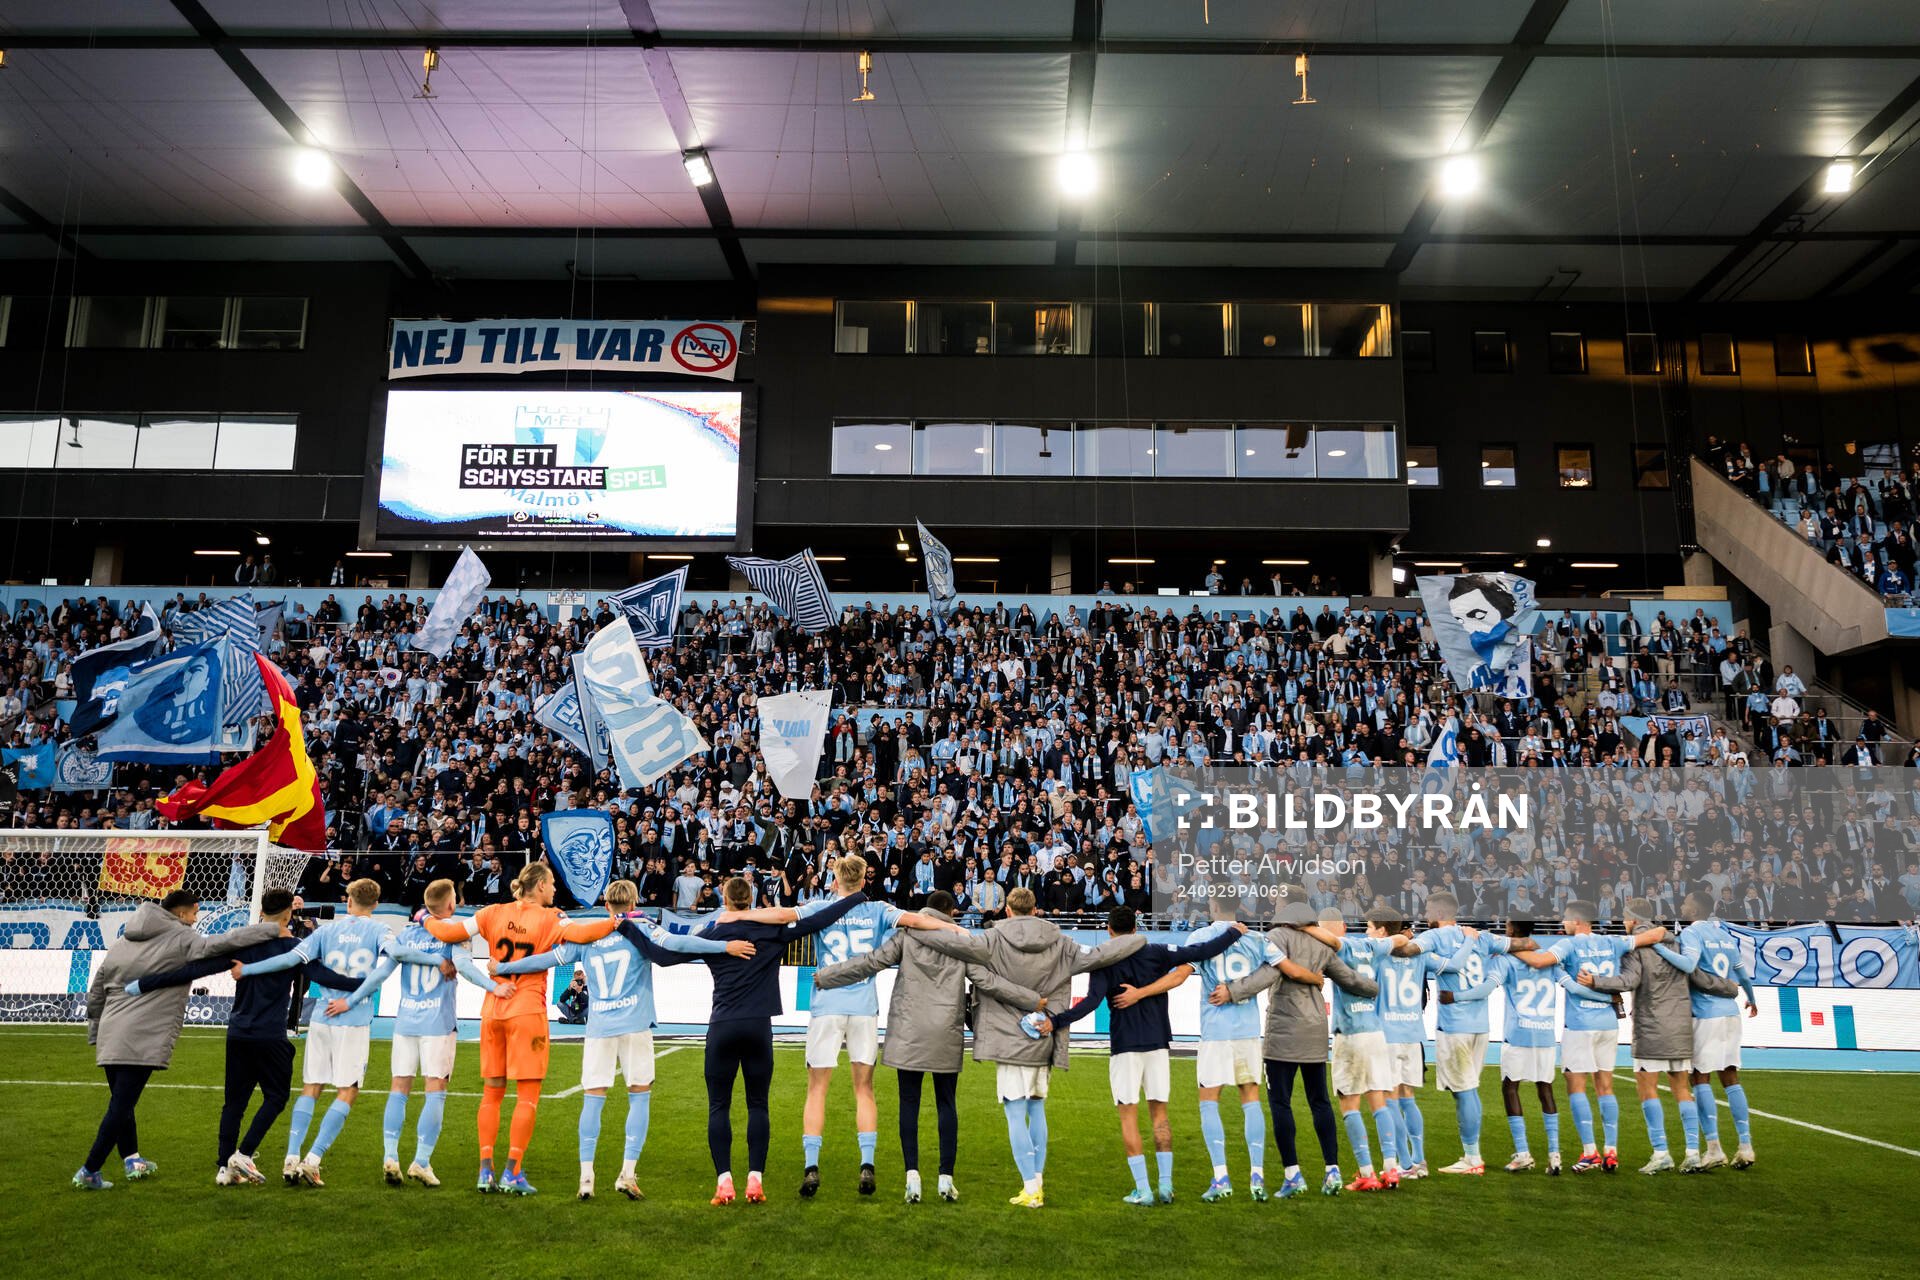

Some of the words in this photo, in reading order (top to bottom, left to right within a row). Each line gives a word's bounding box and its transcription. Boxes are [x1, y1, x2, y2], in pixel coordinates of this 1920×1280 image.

[392, 328, 467, 369] NEJ
[477, 327, 561, 364] TILL
[575, 328, 666, 362] VAR
[688, 340, 721, 354] VAR
[465, 444, 507, 466] FÖR
[512, 448, 553, 466] ETT
[464, 468, 603, 486] SCHYSSTARE
[609, 469, 663, 488] SPEL
[504, 488, 580, 506] Malmö
[823, 928, 875, 966] 35
[1730, 928, 1900, 988] 1910
[590, 949, 631, 1000] 17
[1385, 967, 1421, 1008] 16
[1516, 977, 1555, 1017] 22
